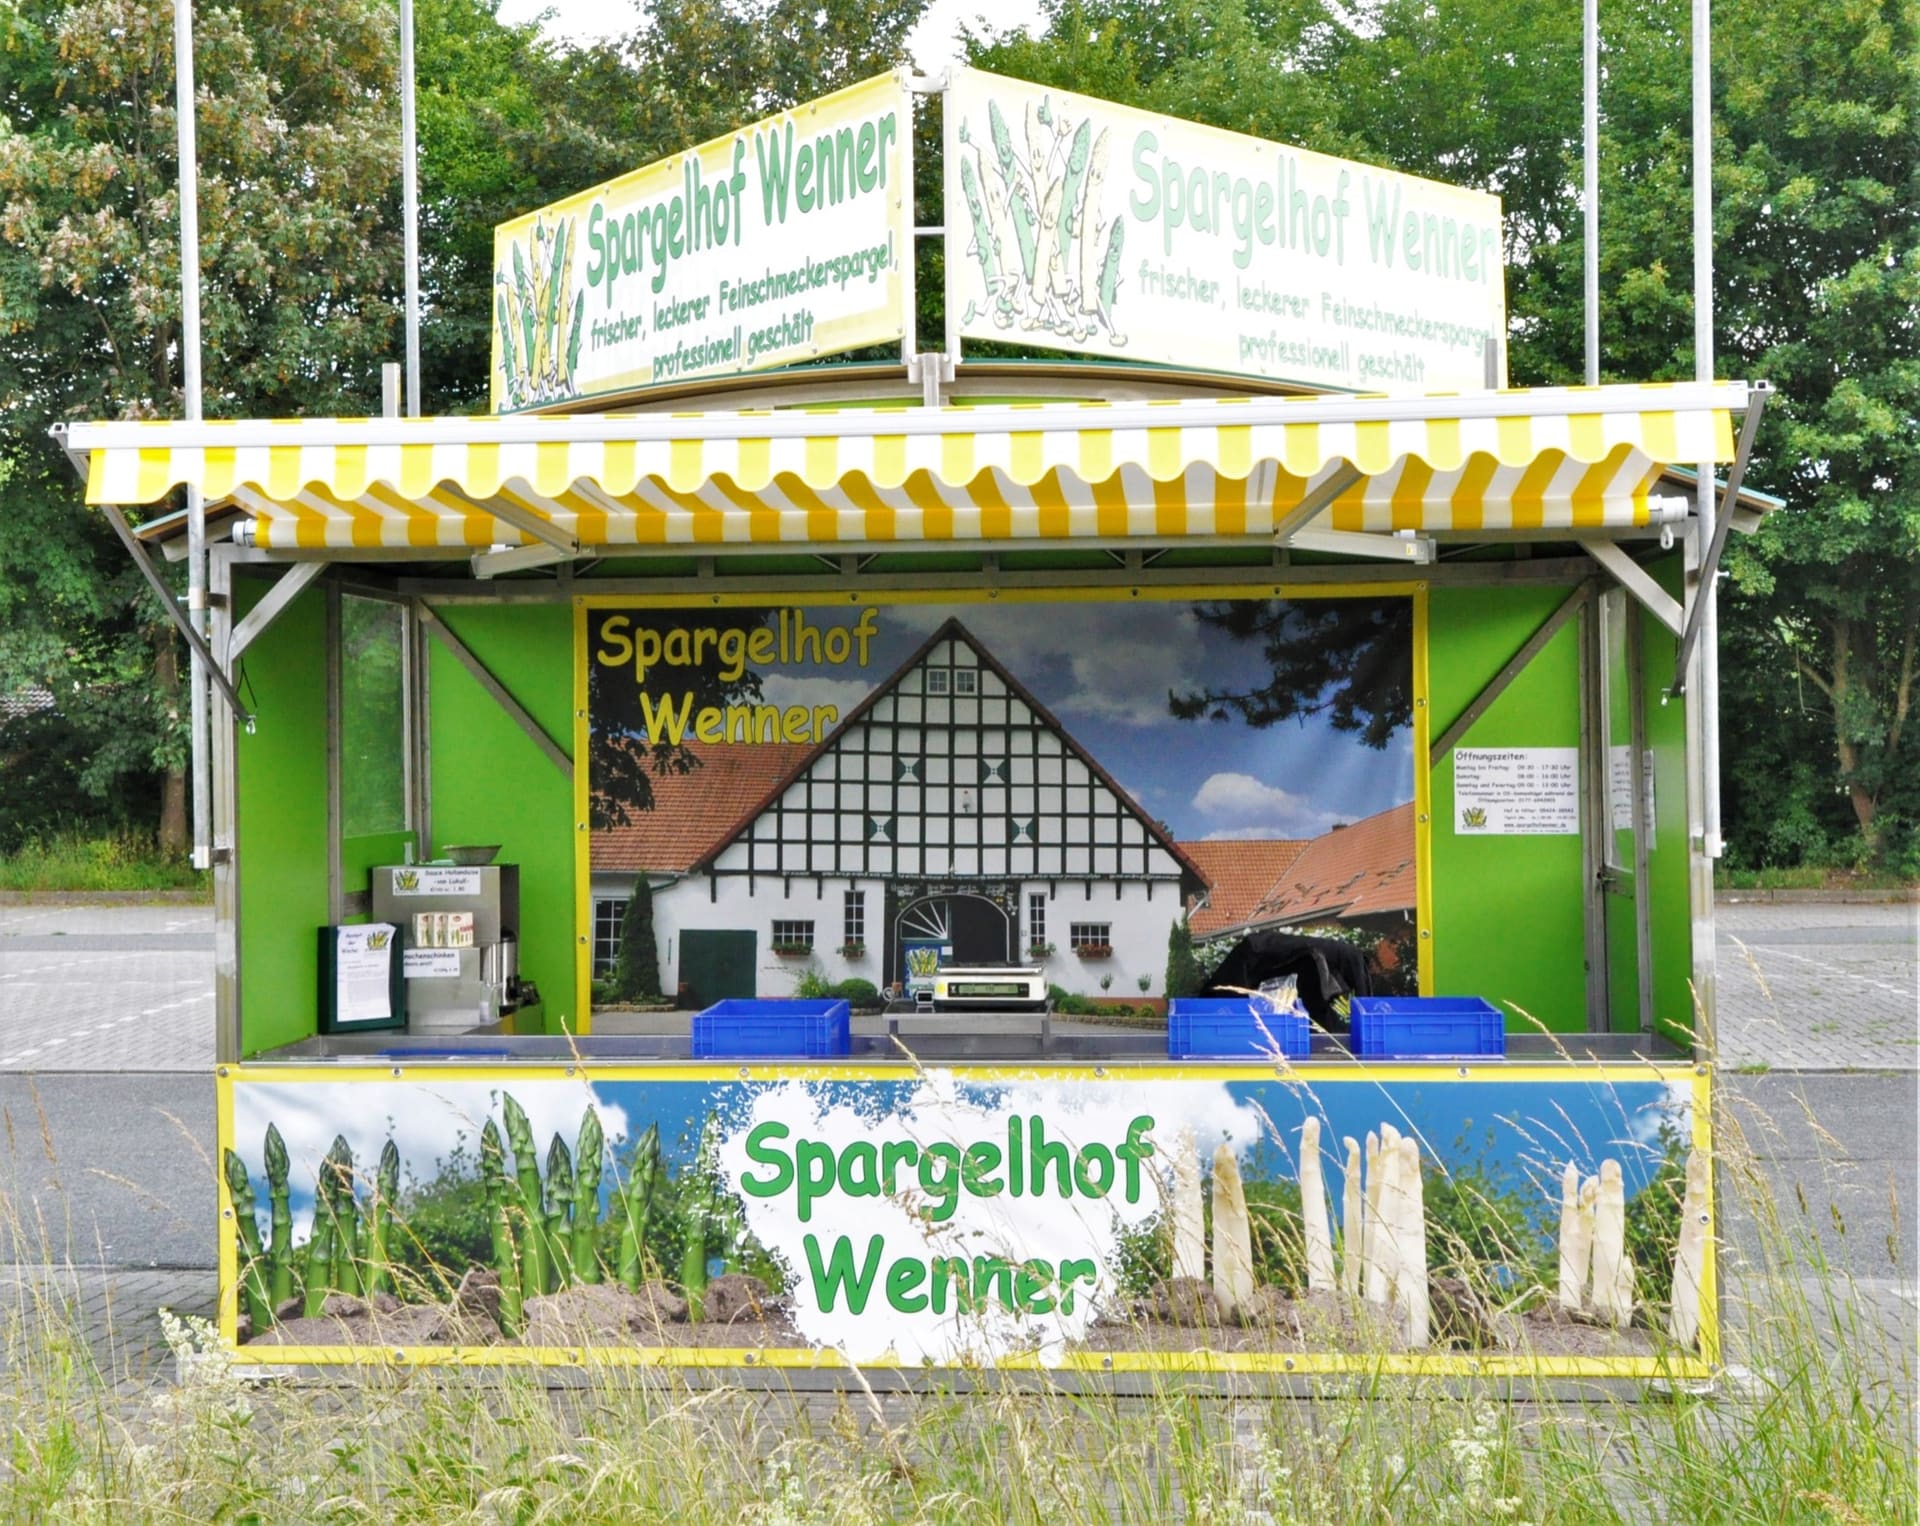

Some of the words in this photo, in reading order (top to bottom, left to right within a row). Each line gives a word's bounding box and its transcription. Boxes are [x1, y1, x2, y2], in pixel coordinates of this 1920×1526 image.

[586, 138, 746, 308] Spargelhof
[756, 111, 897, 225] Wenner
[1129, 129, 1351, 269] Spargelhof
[1363, 175, 1496, 284] Wenner
[591, 307, 646, 353] frischer,
[653, 293, 710, 332] leckerer
[1138, 261, 1226, 311] frischer,
[1236, 275, 1311, 316] leckerer
[652, 326, 742, 382] professionell
[747, 309, 814, 365] geschält
[1239, 333, 1349, 374] professionell
[1358, 349, 1425, 385] geschält
[597, 607, 879, 684] Spargelhof
[640, 691, 839, 746] Wenner
[1456, 751, 1528, 762] Öffnungszeiten:
[740, 1114, 1156, 1222] Spargelhof
[802, 1233, 1098, 1317] Wenner
